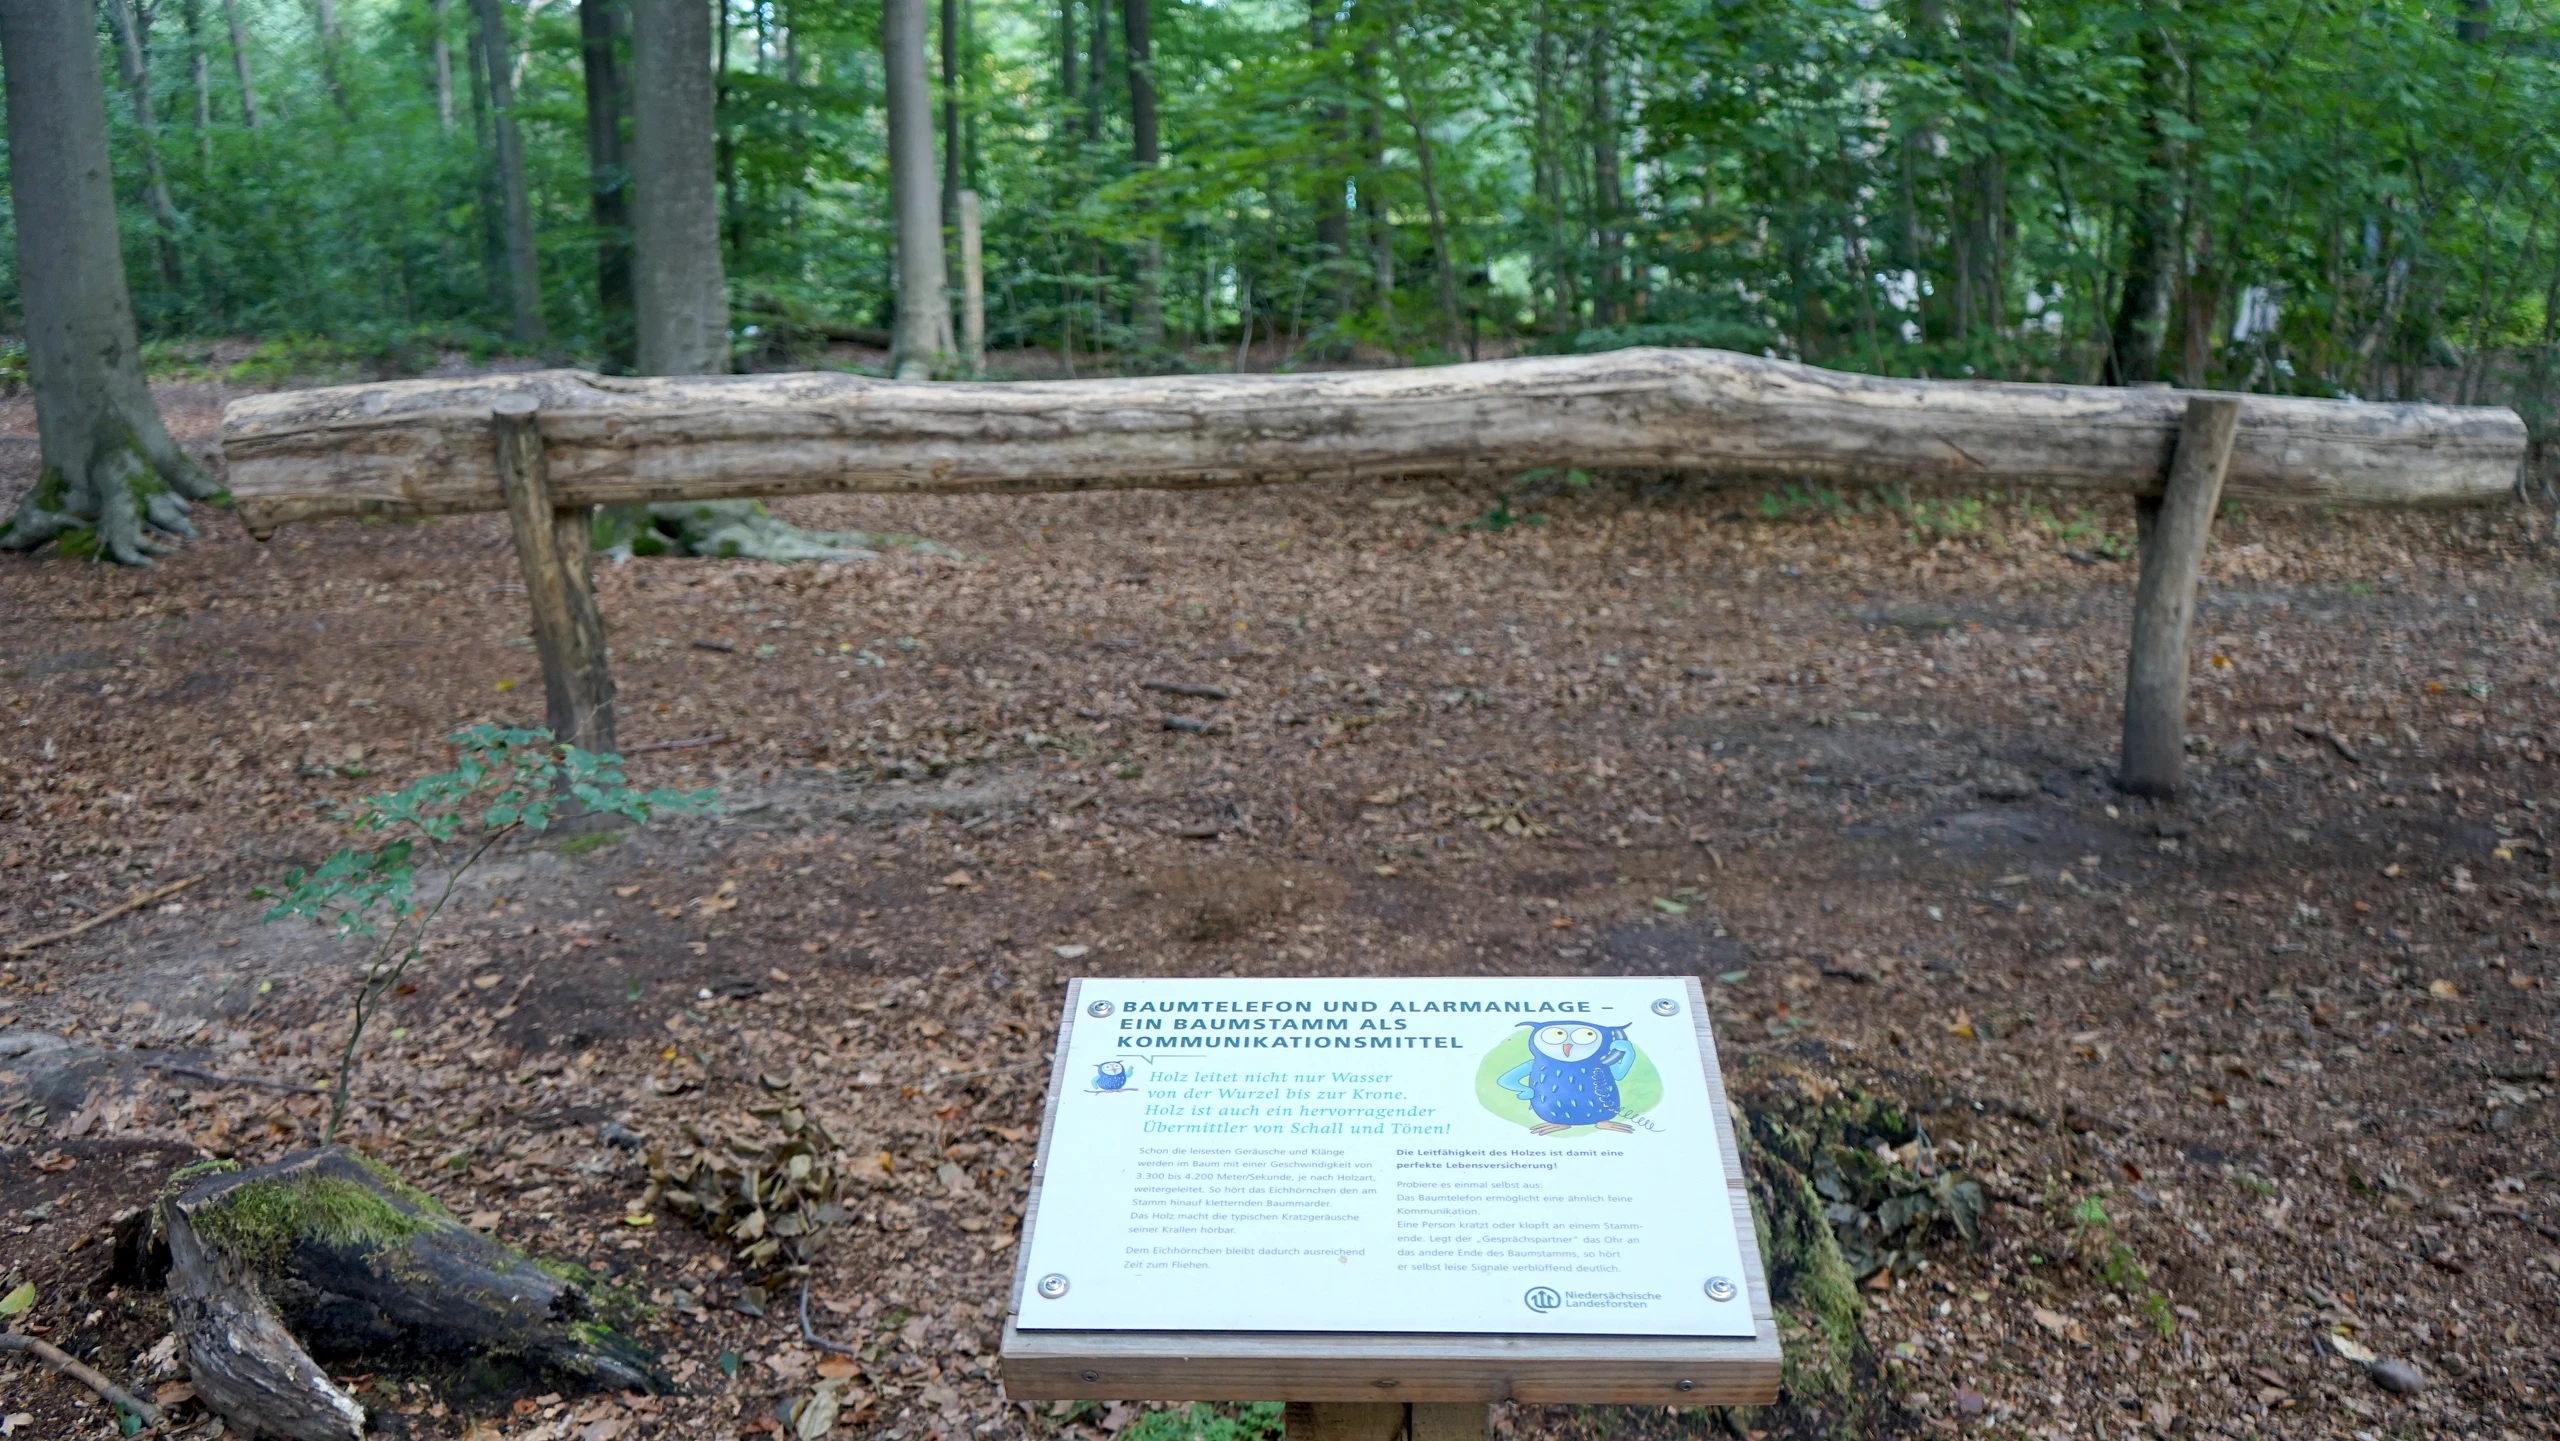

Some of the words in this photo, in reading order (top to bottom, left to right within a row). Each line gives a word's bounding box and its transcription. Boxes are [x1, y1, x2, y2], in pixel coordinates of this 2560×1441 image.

[1122, 1000, 1312, 1013] BAUMTELEFON
[1323, 1001, 1378, 1013] UND
[1388, 1001, 1591, 1013] ALARMANLAGE
[1120, 1018, 1163, 1030] EIN
[1173, 1018, 1348, 1031] BAUMSTAMM
[1359, 1018, 1408, 1031] ALS
[1117, 1035, 1464, 1049] KOMMUNIKATIONSMITTEL
[1149, 1071, 1189, 1083] Holz
[1194, 1071, 1239, 1083] leitet
[1244, 1071, 1289, 1083] nicht
[1294, 1074, 1326, 1083] nur
[1331, 1071, 1393, 1083] Wasser
[1147, 1090, 1177, 1099] von
[1183, 1087, 1213, 1099] der
[1218, 1087, 1280, 1100] Wurzel
[1285, 1087, 1311, 1100] bis
[1316, 1091, 1348, 1100] zur
[1351, 1088, 1407, 1100] Krone.
[1144, 1104, 1185, 1117] Holz
[1190, 1104, 1213, 1117] ist
[1218, 1104, 1260, 1117] auch
[1266, 1105, 1293, 1117] ein
[1299, 1104, 1437, 1120] hervorragender
[1143, 1119, 1248, 1134] Übermittler
[1253, 1124, 1284, 1134] von
[1290, 1121, 1344, 1135] Schall
[1350, 1121, 1385, 1135] und
[1390, 1122, 1451, 1135] Tönen!
[1139, 1146, 1169, 1155] Schon
[1171, 1147, 1187, 1155] die
[1189, 1147, 1232, 1156] leisesten
[1234, 1147, 1286, 1156] Geräusche
[1288, 1148, 1308, 1156] und
[1311, 1148, 1345, 1158] Klänge
[1396, 1148, 1414, 1156] Die
[1417, 1148, 1486, 1158] Leitfähigkeit
[1488, 1149, 1508, 1157] des
[1510, 1149, 1547, 1157] Holzes
[1549, 1149, 1564, 1157] ist
[1565, 1149, 1598, 1157] damit
[1600, 1149, 1624, 1157] eine
[1137, 1159, 1174, 1168] werden
[1176, 1159, 1190, 1168] im
[1192, 1160, 1220, 1168] Baum
[1223, 1160, 1240, 1168] mit
[1242, 1160, 1268, 1168] einer
[1270, 1160, 1352, 1170] Geschwindigkeit
[1396, 1161, 1443, 1170] perfekte
[1445, 1161, 1558, 1171] Lebensversicherung!
[1135, 1172, 1165, 1180] 3.300
[1167, 1172, 1182, 1181] bis
[1184, 1172, 1214, 1181] 4.200
[1216, 1173, 1295, 1182] Meter/Sekunde,
[1297, 1173, 1308, 1183] je
[1310, 1173, 1334, 1182] nach
[1337, 1173, 1376, 1183] Holzart,
[1133, 1185, 1205, 1195] weitergeleitet.
[1208, 1185, 1222, 1194] So
[1224, 1185, 1246, 1194] hört
[1248, 1186, 1266, 1194] das
[1268, 1186, 1337, 1195] Eichhörnchen
[1339, 1186, 1359, 1195] den
[1396, 1180, 1438, 1189] Probiere
[1453, 1180, 1488, 1189] einmal
[1490, 1180, 1520, 1189] selbst
[1131, 1198, 1167, 1207] Stamm
[1169, 1198, 1203, 1207] hinauf
[1205, 1198, 1264, 1207] kletternden
[1266, 1199, 1332, 1208] Baummarder.
[1396, 1193, 1416, 1202] Das
[1418, 1193, 1483, 1202] Baumtelefon
[1485, 1194, 1540, 1204] ermöglicht
[1542, 1194, 1565, 1203] eine
[1567, 1194, 1605, 1203] ähnlich
[1606, 1194, 1634, 1203] feine
[1130, 1211, 1149, 1220] Das
[1151, 1212, 1175, 1220] Holz
[1177, 1212, 1209, 1221] macht
[1211, 1212, 1228, 1221] die
[1230, 1212, 1279, 1222] typischen
[1281, 1213, 1360, 1223] Kratzgeräusche
[1396, 1207, 1481, 1216] Kommunikation.
[1128, 1225, 1159, 1234] seiner
[1161, 1225, 1198, 1234] Krallen
[1200, 1225, 1237, 1234] hörbar.
[1397, 1220, 1419, 1229] Eine
[1421, 1220, 1456, 1229] Person
[1459, 1220, 1489, 1230] kratzt
[1491, 1221, 1517, 1230] oder
[1518, 1221, 1550, 1231] klopft
[1568, 1221, 1601, 1230] einem
[1603, 1221, 1644, 1230] Stamm-
[1396, 1234, 1426, 1243] ende.
[1429, 1234, 1452, 1245] Legt
[1454, 1234, 1473, 1243] der
[1582, 1235, 1602, 1244] das
[1603, 1235, 1624, 1244] Ohr
[1626, 1237, 1640, 1245] an
[1125, 1246, 1150, 1255] Dem
[1152, 1246, 1223, 1255] Eichhörnchen
[1225, 1246, 1255, 1255] bleibt
[1258, 1247, 1300, 1256] dadurch
[1303, 1247, 1366, 1256] ausreichend
[1397, 1248, 1416, 1257] das
[1418, 1248, 1455, 1257] andere
[1457, 1248, 1484, 1257] Ende
[1486, 1248, 1505, 1258] des
[1507, 1249, 1581, 1259] Baumstamms,
[1583, 1251, 1596, 1259] so
[1598, 1249, 1622, 1259] hört
[1123, 1259, 1144, 1269] Zeit
[1171, 1260, 1211, 1269] Fliehen.
[1411, 1262, 1442, 1271] selbst
[1444, 1262, 1469, 1272] leise
[1470, 1263, 1509, 1274] Signale
[1511, 1263, 1573, 1273] verblüffend
[1575, 1263, 1622, 1273] deutlich.
[1564, 1290, 1662, 1300] Niedersächsische
[1565, 1300, 1648, 1309] Landesforsten
